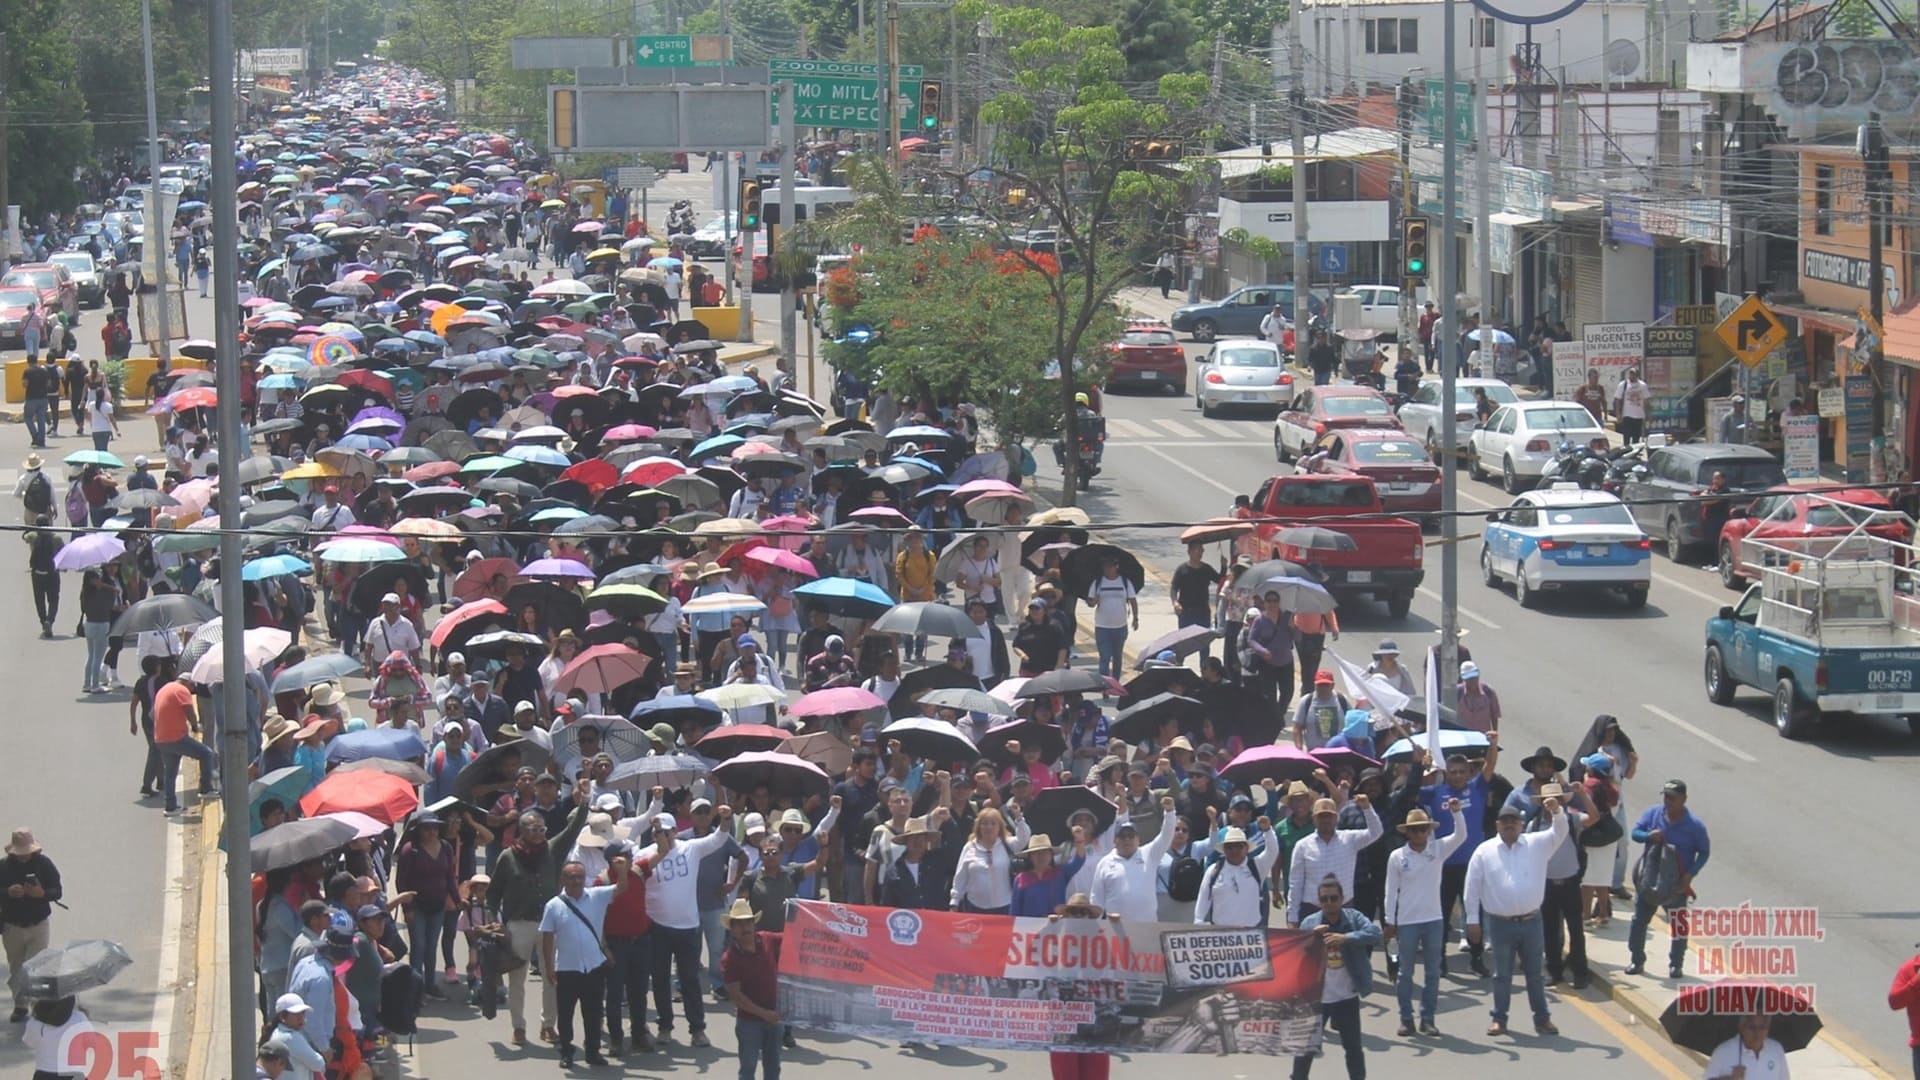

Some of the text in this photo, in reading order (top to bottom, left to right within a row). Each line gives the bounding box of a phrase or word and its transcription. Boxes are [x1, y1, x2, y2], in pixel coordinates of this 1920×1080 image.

[654, 41, 687, 49] CENTRO
[771, 103, 880, 121] TXTEPEC
[1675, 308, 1716, 325] FOTOS
[1587, 333, 1642, 343] URGENTES
[1648, 330, 1694, 341] FOTOS
[1586, 343, 1597, 351] EN
[1556, 367, 1584, 377] VISA
[656, 854, 689, 883] 199
[1169, 934, 1262, 949] EN DEFENSA DE
[1007, 928, 1131, 971] SECCIÓN
[1172, 946, 1264, 964] LA SEGURIDAD
[1188, 961, 1256, 980] SOCIAL
[929, 993, 938, 1002] DE
[941, 995, 951, 1004] LA
[909, 1002, 918, 1010] LA
[994, 1010, 1003, 1018] DE
[1007, 1011, 1016, 1019] LA
[949, 1017, 958, 1025] DE
[962, 1018, 971, 1026] LA
[1243, 1021, 1280, 1035] CNTE
